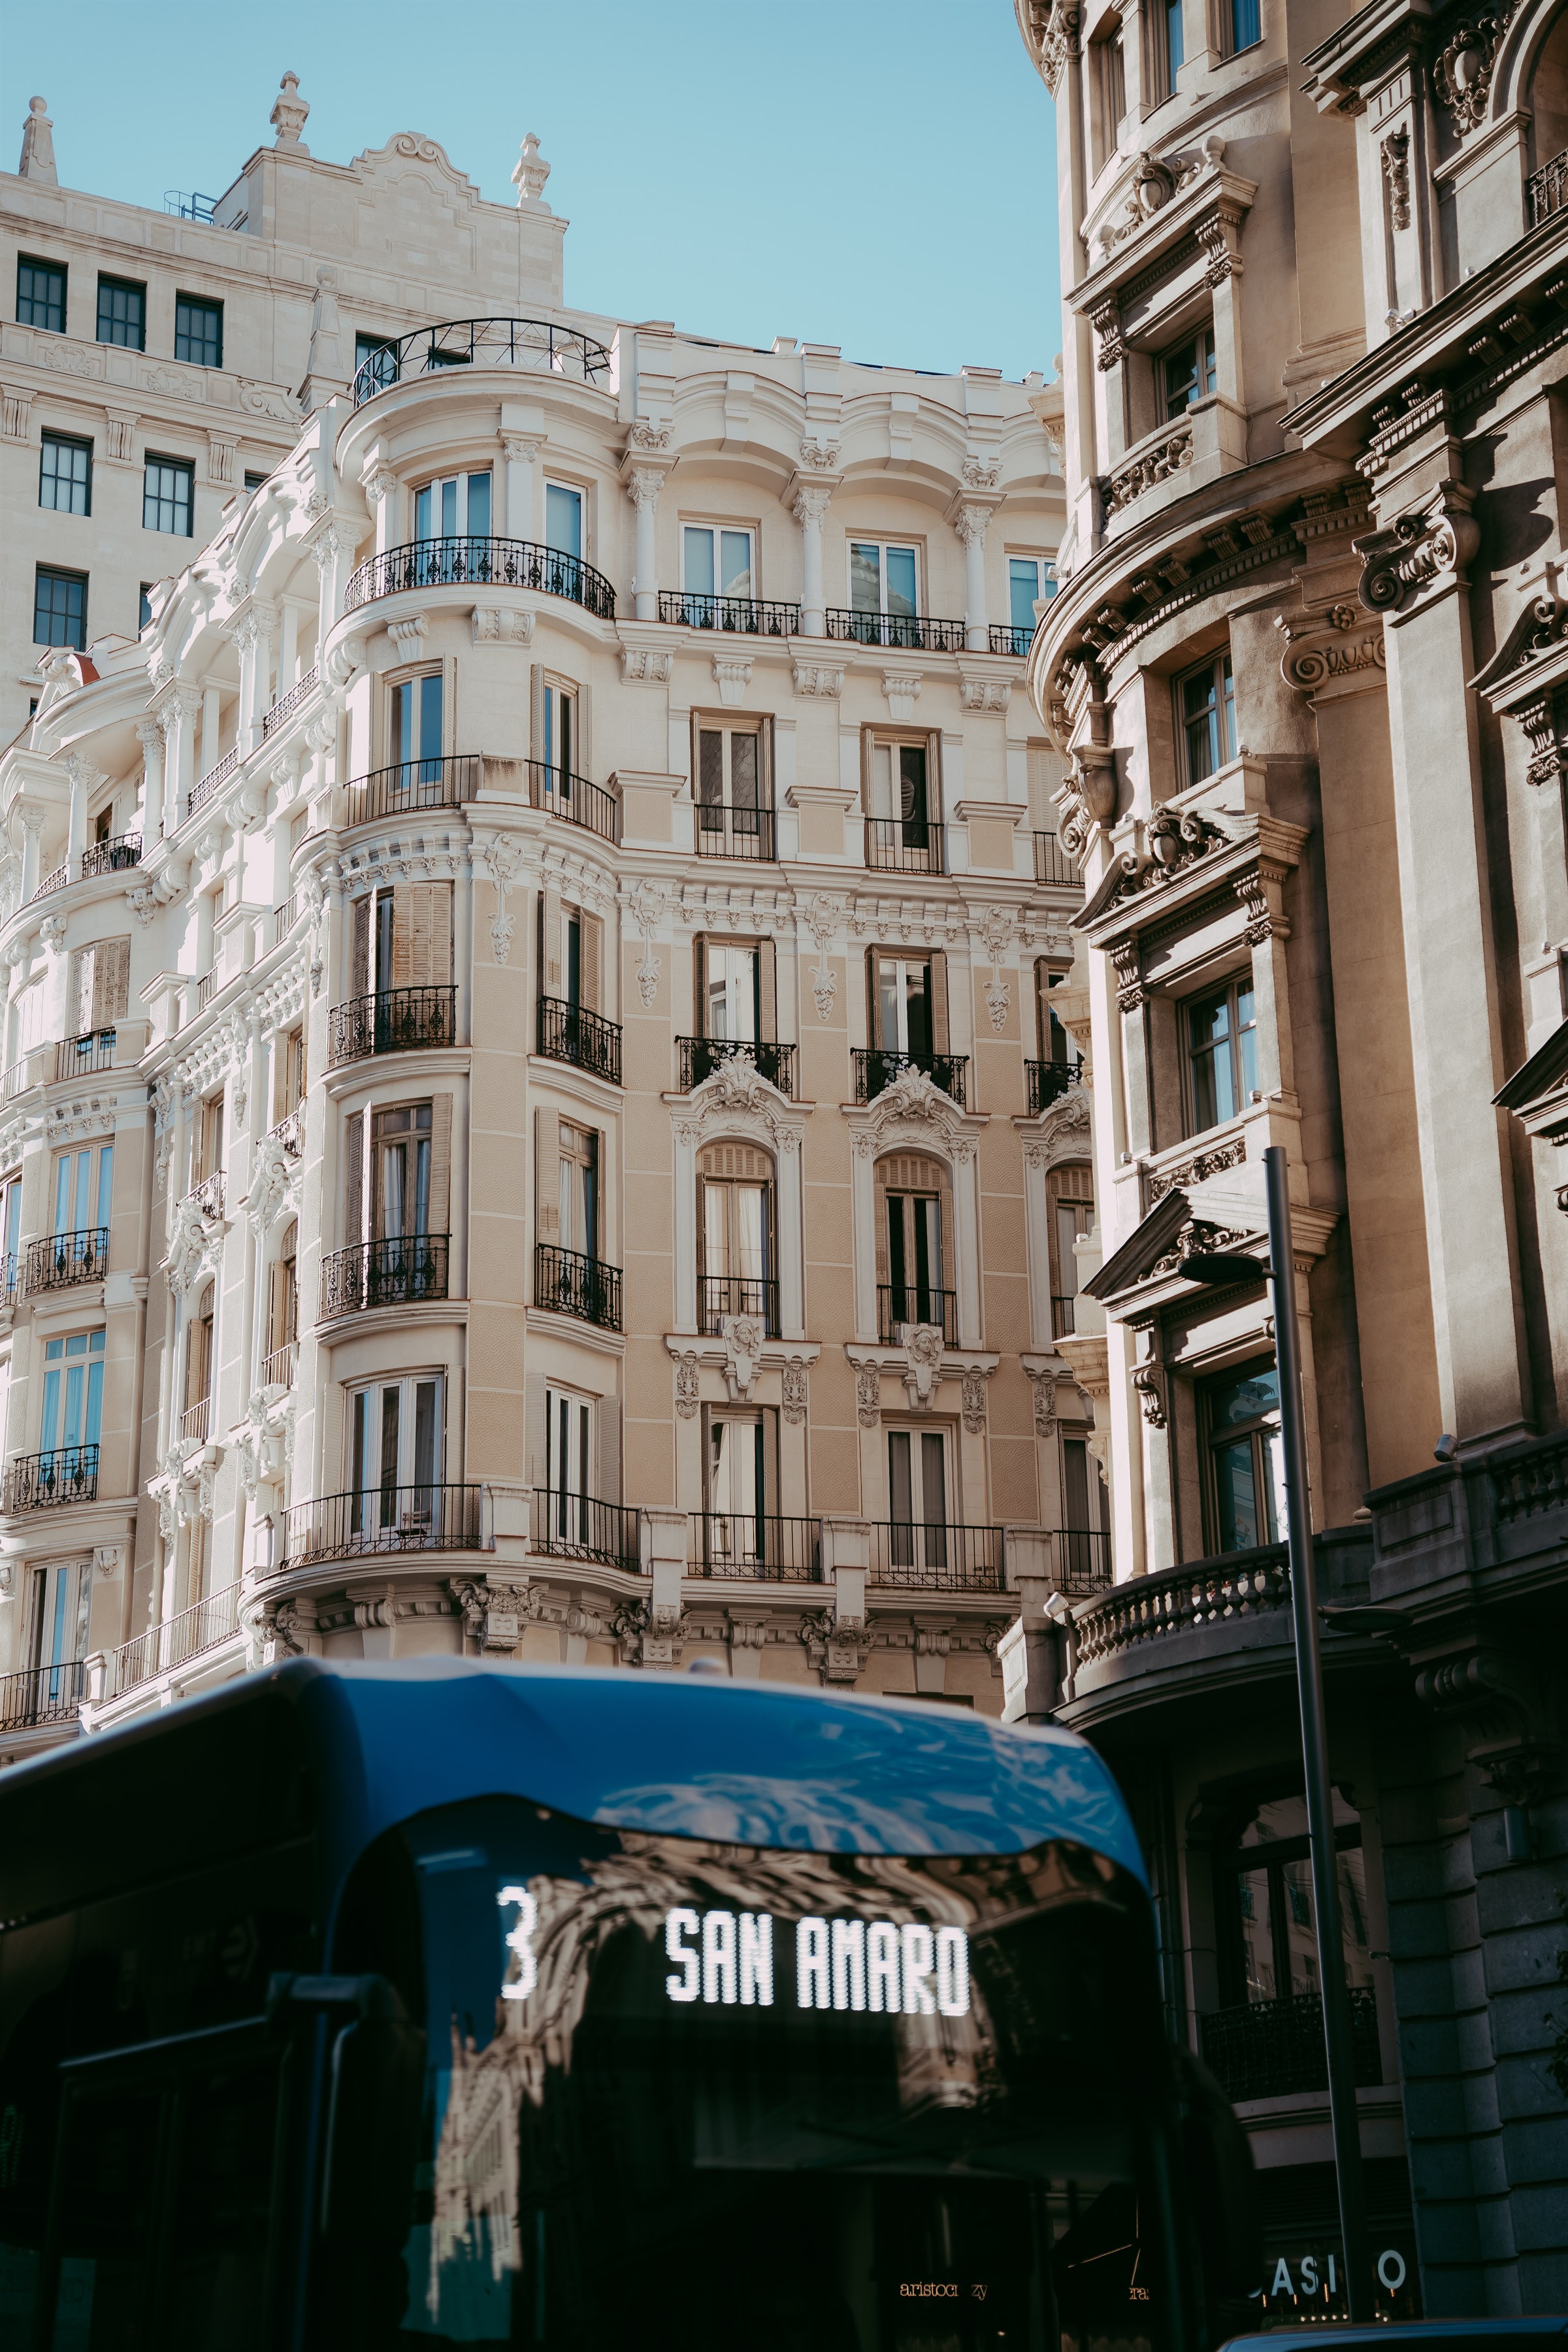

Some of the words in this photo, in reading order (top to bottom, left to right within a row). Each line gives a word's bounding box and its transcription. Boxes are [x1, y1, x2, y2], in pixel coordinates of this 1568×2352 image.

[497, 1886, 536, 1999] 3
[666, 1908, 773, 2005] SAN
[796, 1917, 970, 2016] AMARO
